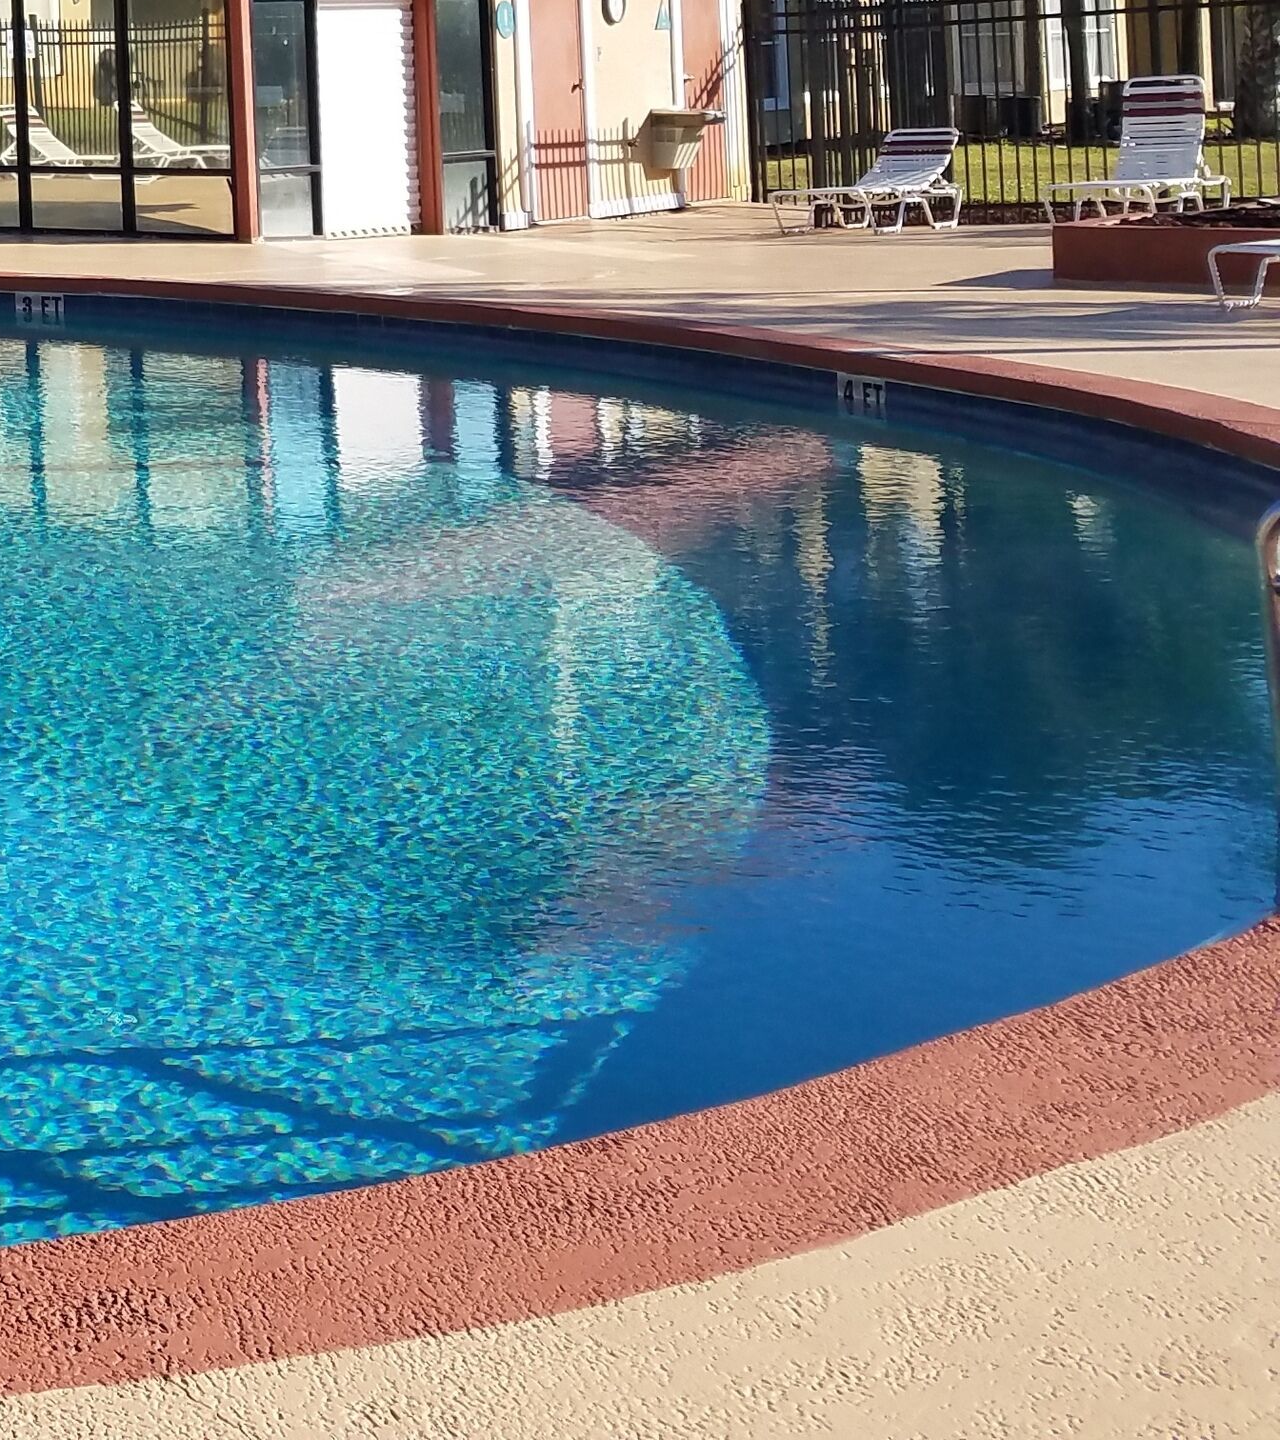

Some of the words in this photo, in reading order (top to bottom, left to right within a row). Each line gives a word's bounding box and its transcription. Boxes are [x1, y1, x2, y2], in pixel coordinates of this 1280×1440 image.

[22, 296, 33, 313] 3
[41, 296, 62, 314] FT
[843, 379, 854, 401] 4
[862, 382, 883, 404] FT
